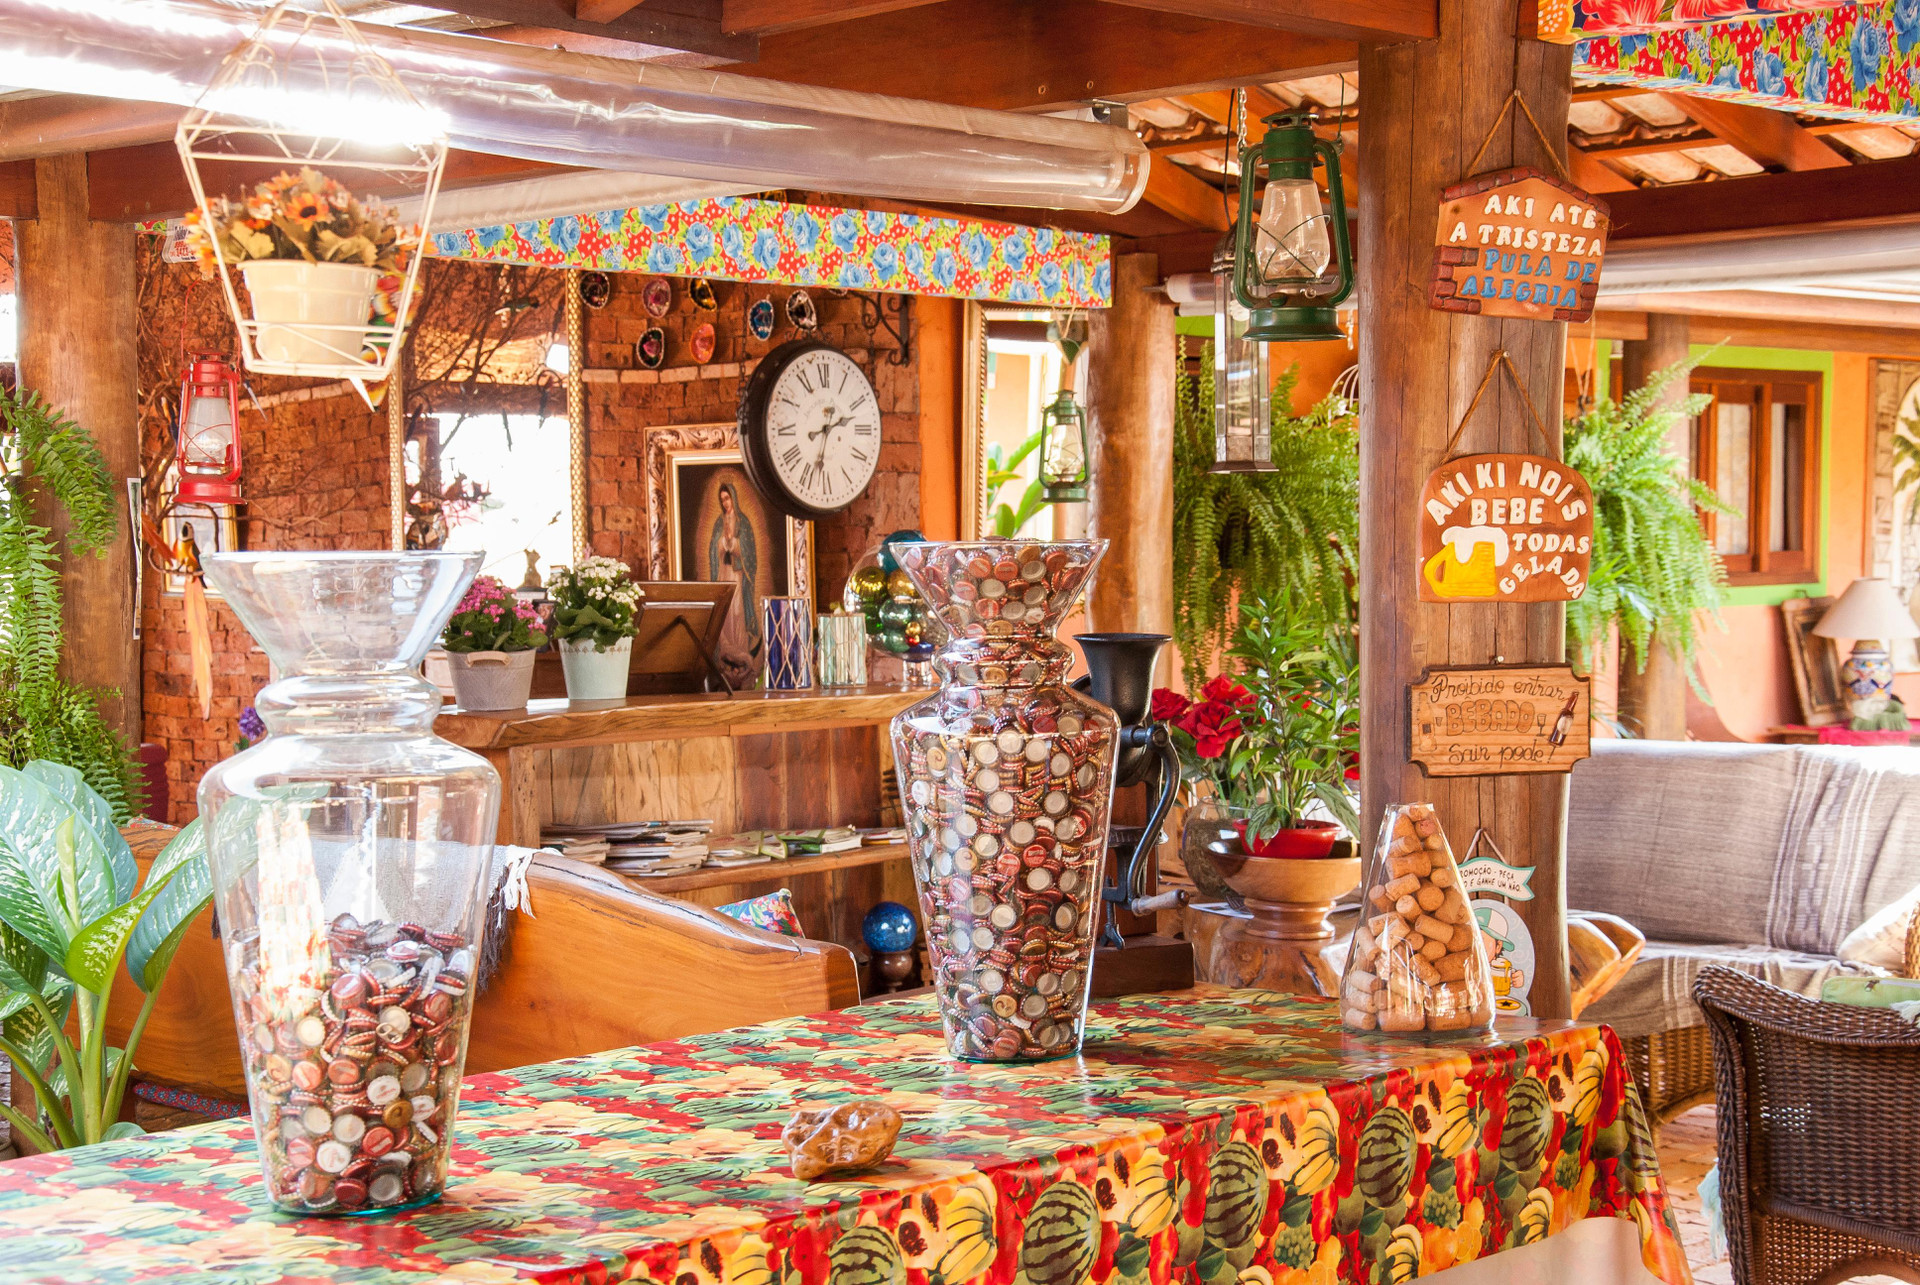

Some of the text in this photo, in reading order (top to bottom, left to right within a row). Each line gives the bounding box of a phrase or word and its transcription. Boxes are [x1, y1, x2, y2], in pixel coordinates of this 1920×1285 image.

[1484, 194, 1597, 229] AKI ATE
[1449, 221, 1602, 258] A TRISTEZA
[1484, 248, 1597, 283] PULA DE
[1461, 275, 1577, 308] ALEGRIA
[1519, 461, 1587, 521] NOIS
[1470, 497, 1544, 526] BEBE
[1512, 533, 1590, 554] TODAS
[1499, 555, 1585, 599] GELADA
[1431, 674, 1505, 703] Proibido
[1449, 743, 1491, 765] Sair
[1459, 864, 1492, 878] ROMOÇÃO
[1499, 869, 1514, 881] PEÇA
[1497, 879, 1507, 888] UM
